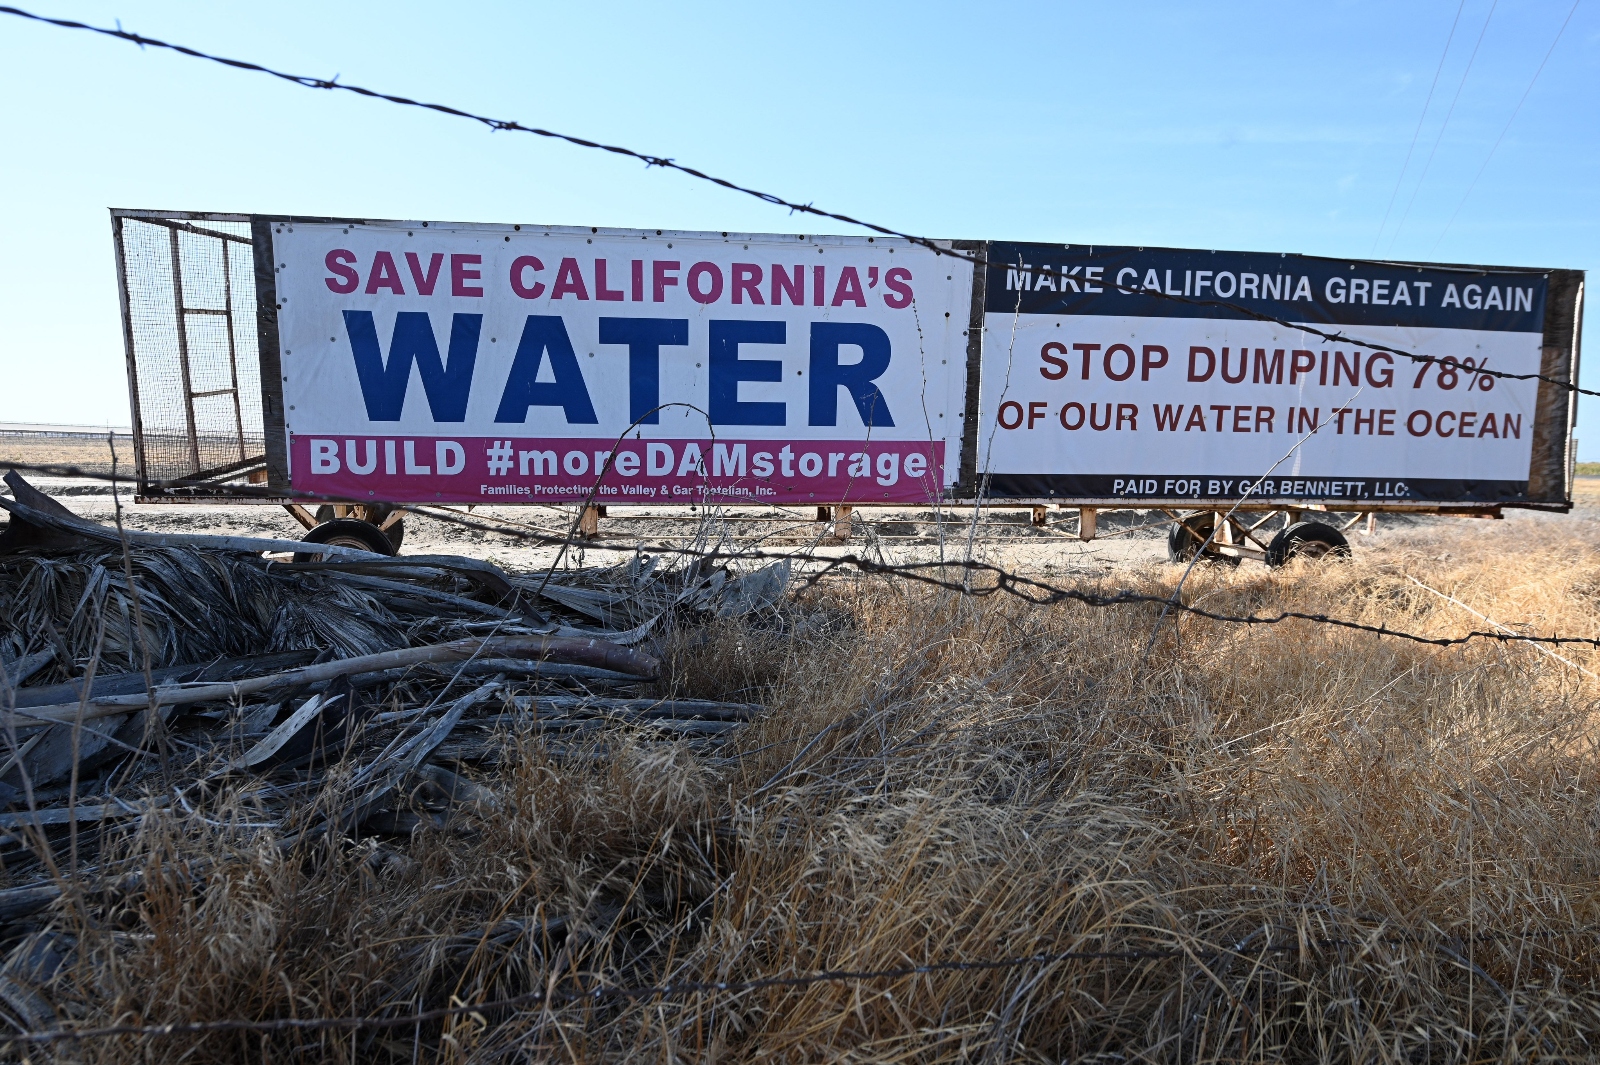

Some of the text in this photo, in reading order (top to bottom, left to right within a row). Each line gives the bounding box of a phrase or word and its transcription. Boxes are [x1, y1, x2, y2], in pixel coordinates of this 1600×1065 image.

[325, 248, 914, 310] SAVE CALIFORNIA'S
[1006, 264, 1532, 312] MAKE CALIFORNIA GREAT AGAIN
[341, 310, 895, 427] WATER
[1040, 342, 1495, 391] STOP DUMPING 78%
[996, 401, 1522, 439] OF OUR WATER IN THE OCEAN
[310, 439, 927, 486] BUILD #moreDAMstorage
[480, 485, 530, 495] Families
[599, 485, 618, 495] the
[621, 485, 657, 496] Valley
[660, 485, 668, 495] &
[672, 485, 693, 495] Gar
[756, 485, 777, 496] Inc.
[1114, 479, 1158, 494] PAID
[1164, 480, 1201, 495] FOR
[1208, 481, 1234, 495] BY
[1238, 481, 1274, 495] GAR
[1280, 481, 1368, 498] BENNETT,
